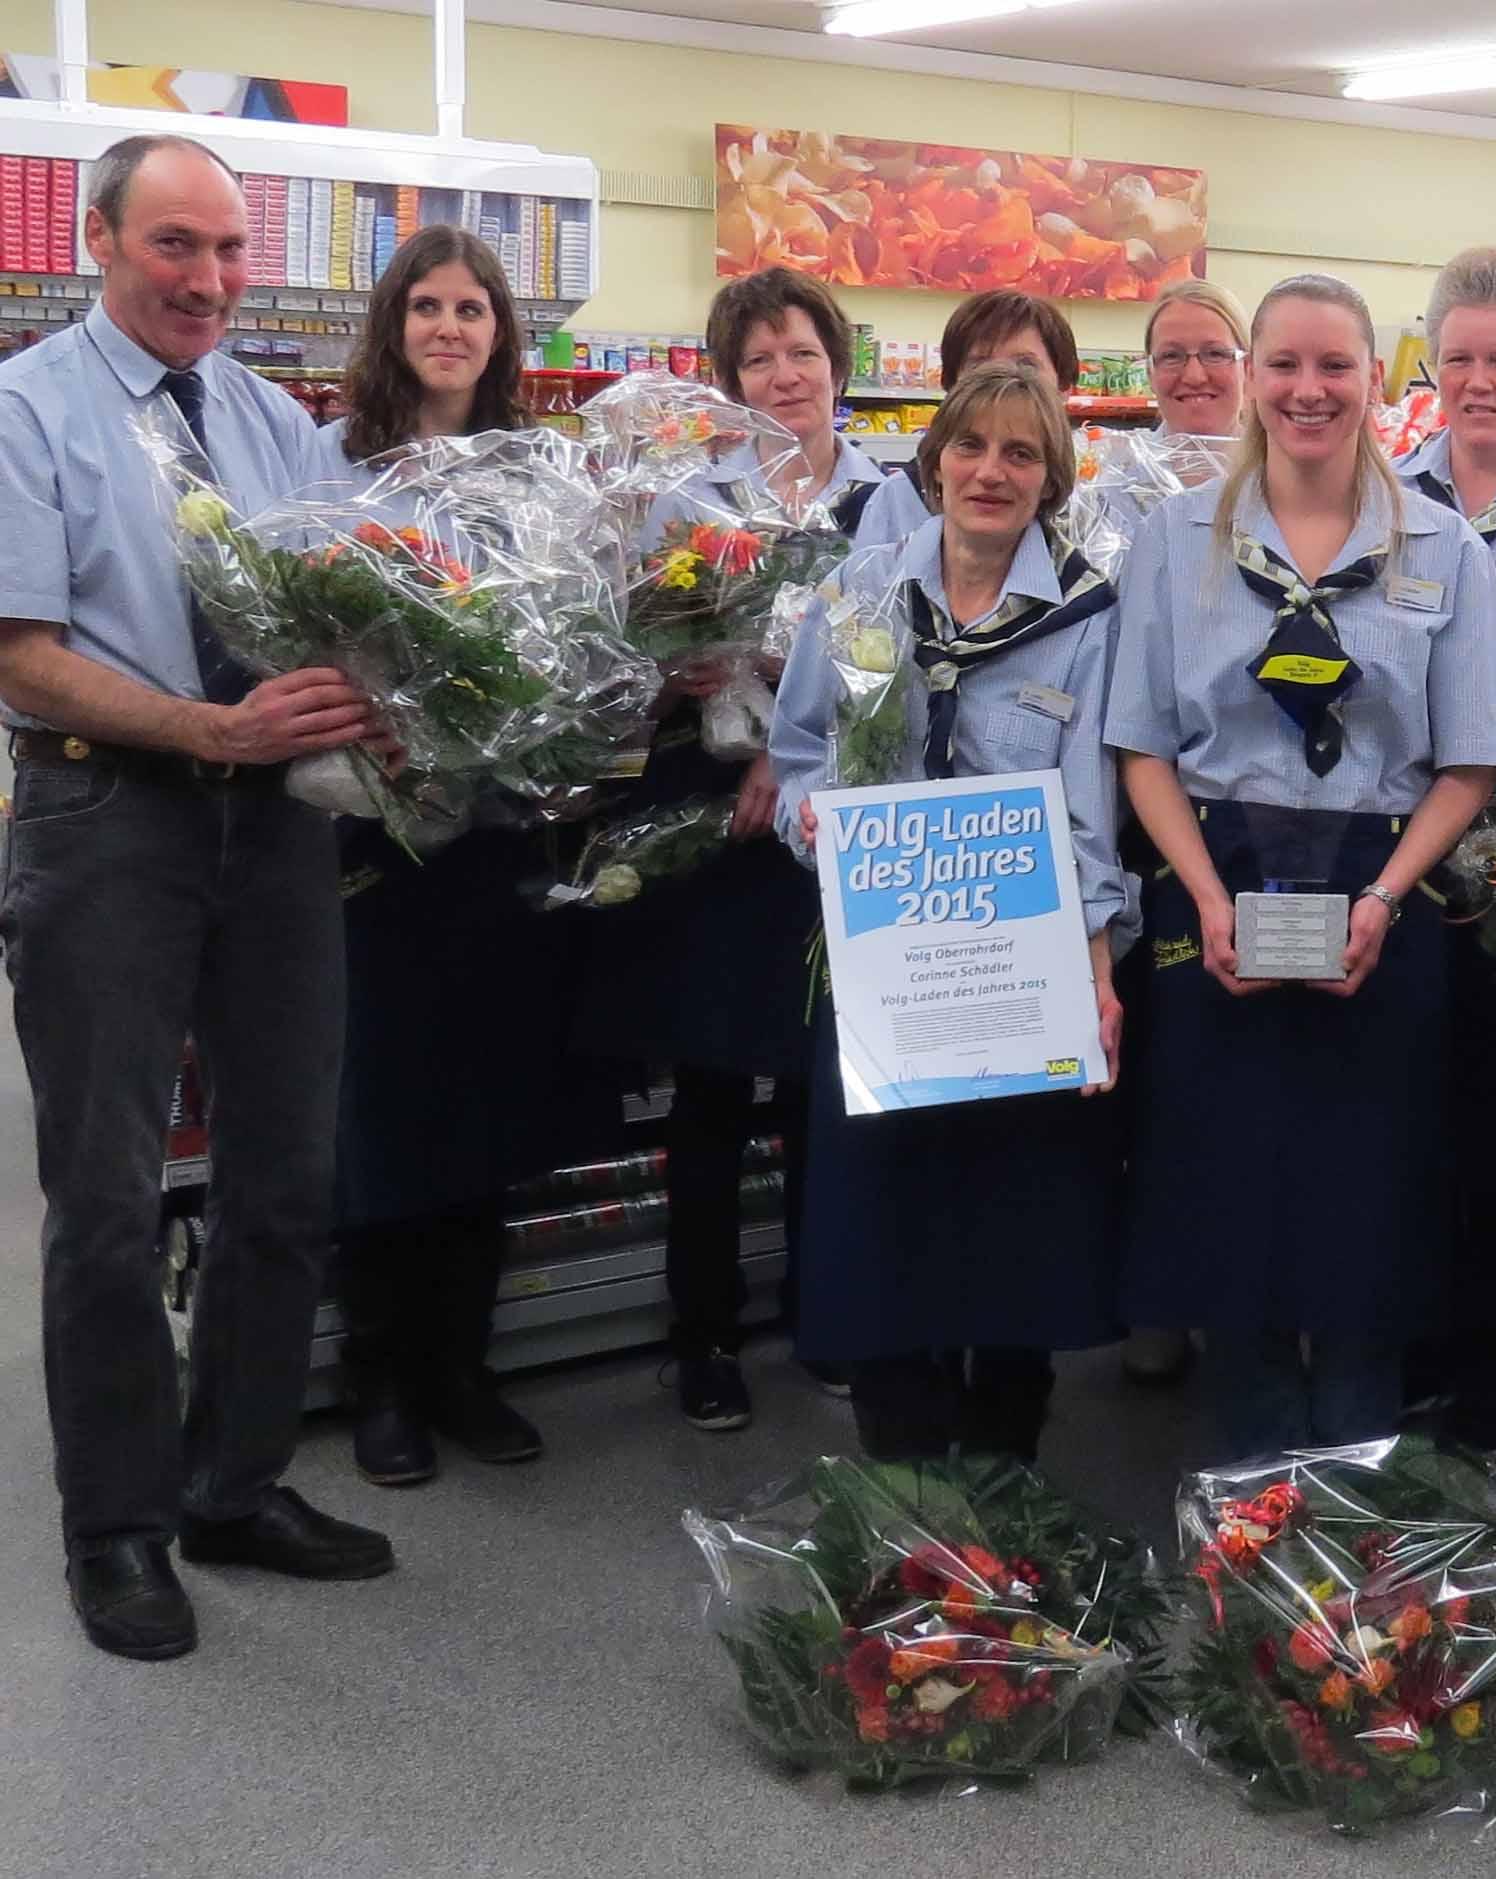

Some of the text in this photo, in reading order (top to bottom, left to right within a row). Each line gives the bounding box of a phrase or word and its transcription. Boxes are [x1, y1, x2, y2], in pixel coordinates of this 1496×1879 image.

[832, 801, 1044, 858] Volg-Laden
[849, 843, 1037, 892] des Jahres
[896, 883, 998, 930] 2015
[904, 940, 1015, 963] Volg Oberrohrdorf
[910, 962, 1014, 984] Corinne Schädler
[880, 978, 1048, 1007] Volg-Laden des Jahres 2015
[1047, 1060, 1079, 1075] Volg
